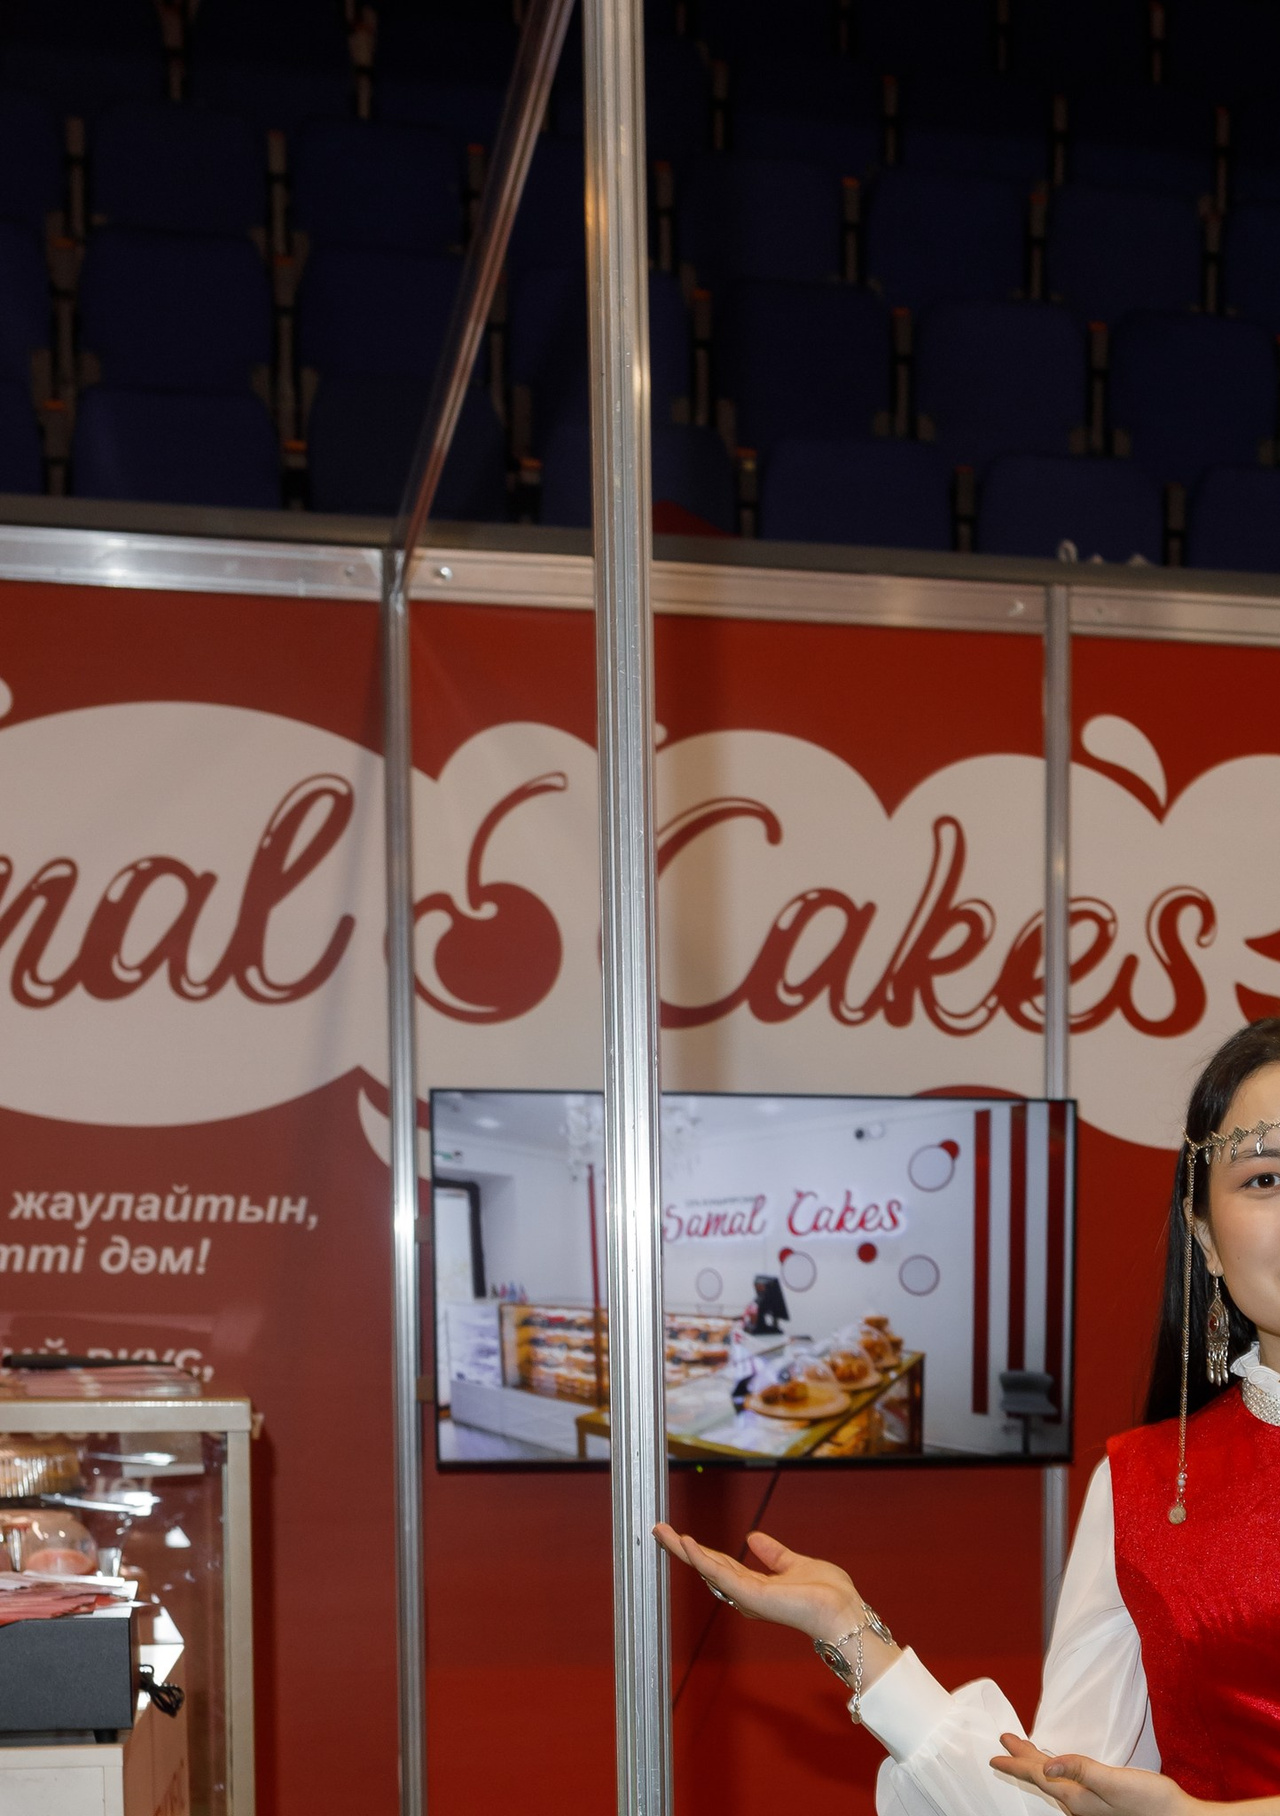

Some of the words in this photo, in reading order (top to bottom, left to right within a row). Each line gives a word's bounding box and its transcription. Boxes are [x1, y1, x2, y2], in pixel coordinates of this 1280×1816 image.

[598, 797, 1217, 1038] Cakes
[9, 1184, 319, 1231] жаулайтын,
[662, 1194, 767, 1243] Samal
[787, 1189, 902, 1237] Cakes
[99, 1234, 213, 1275] дәм!
